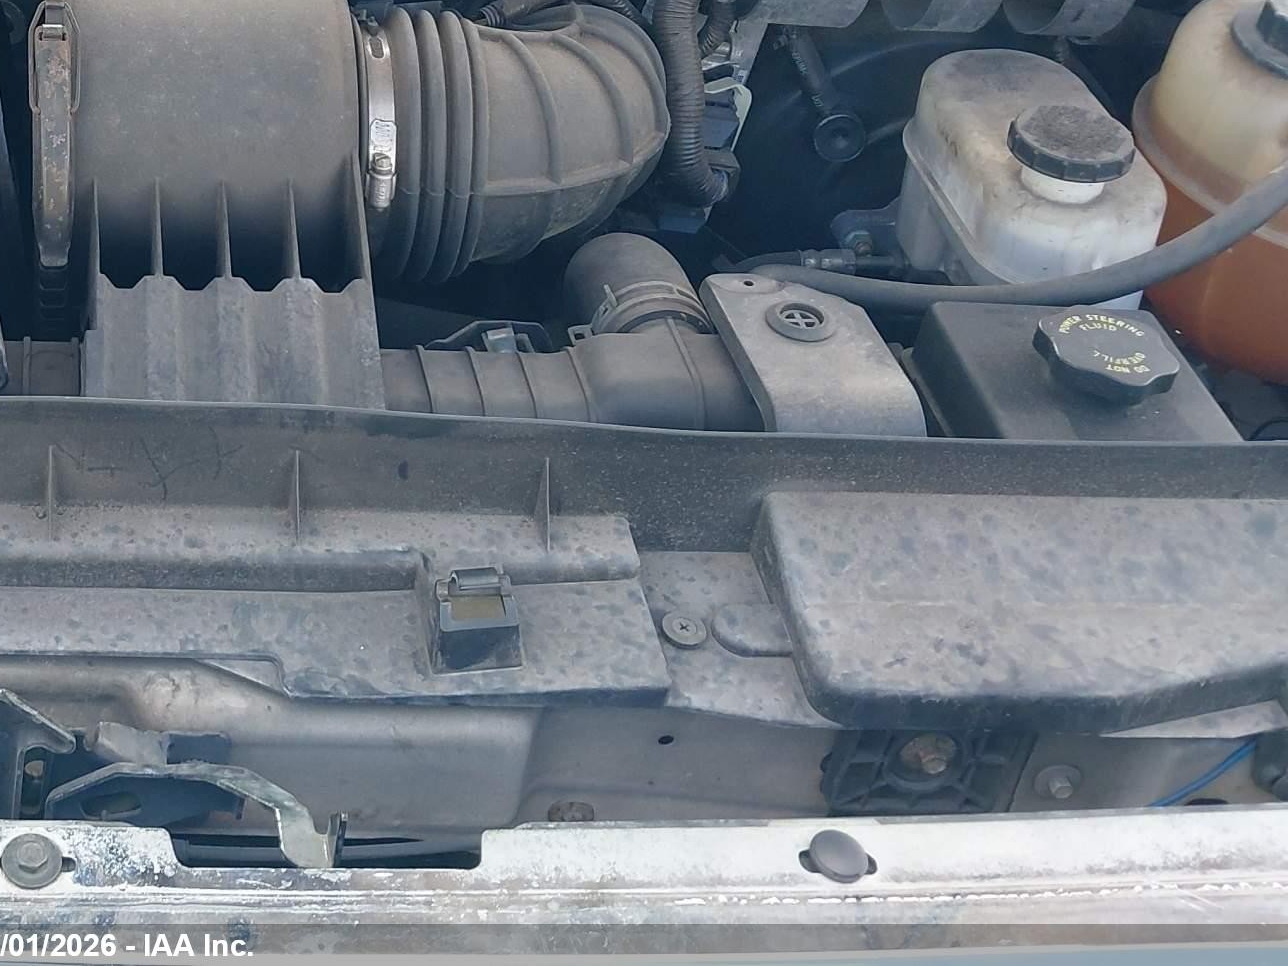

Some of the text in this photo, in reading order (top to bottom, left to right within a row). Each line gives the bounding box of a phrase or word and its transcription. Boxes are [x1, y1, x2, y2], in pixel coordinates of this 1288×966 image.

[1058, 314, 1145, 337] POWER STEERING
[1078, 322, 1118, 332] FLUID
[1105, 364, 1131, 374] NOT
